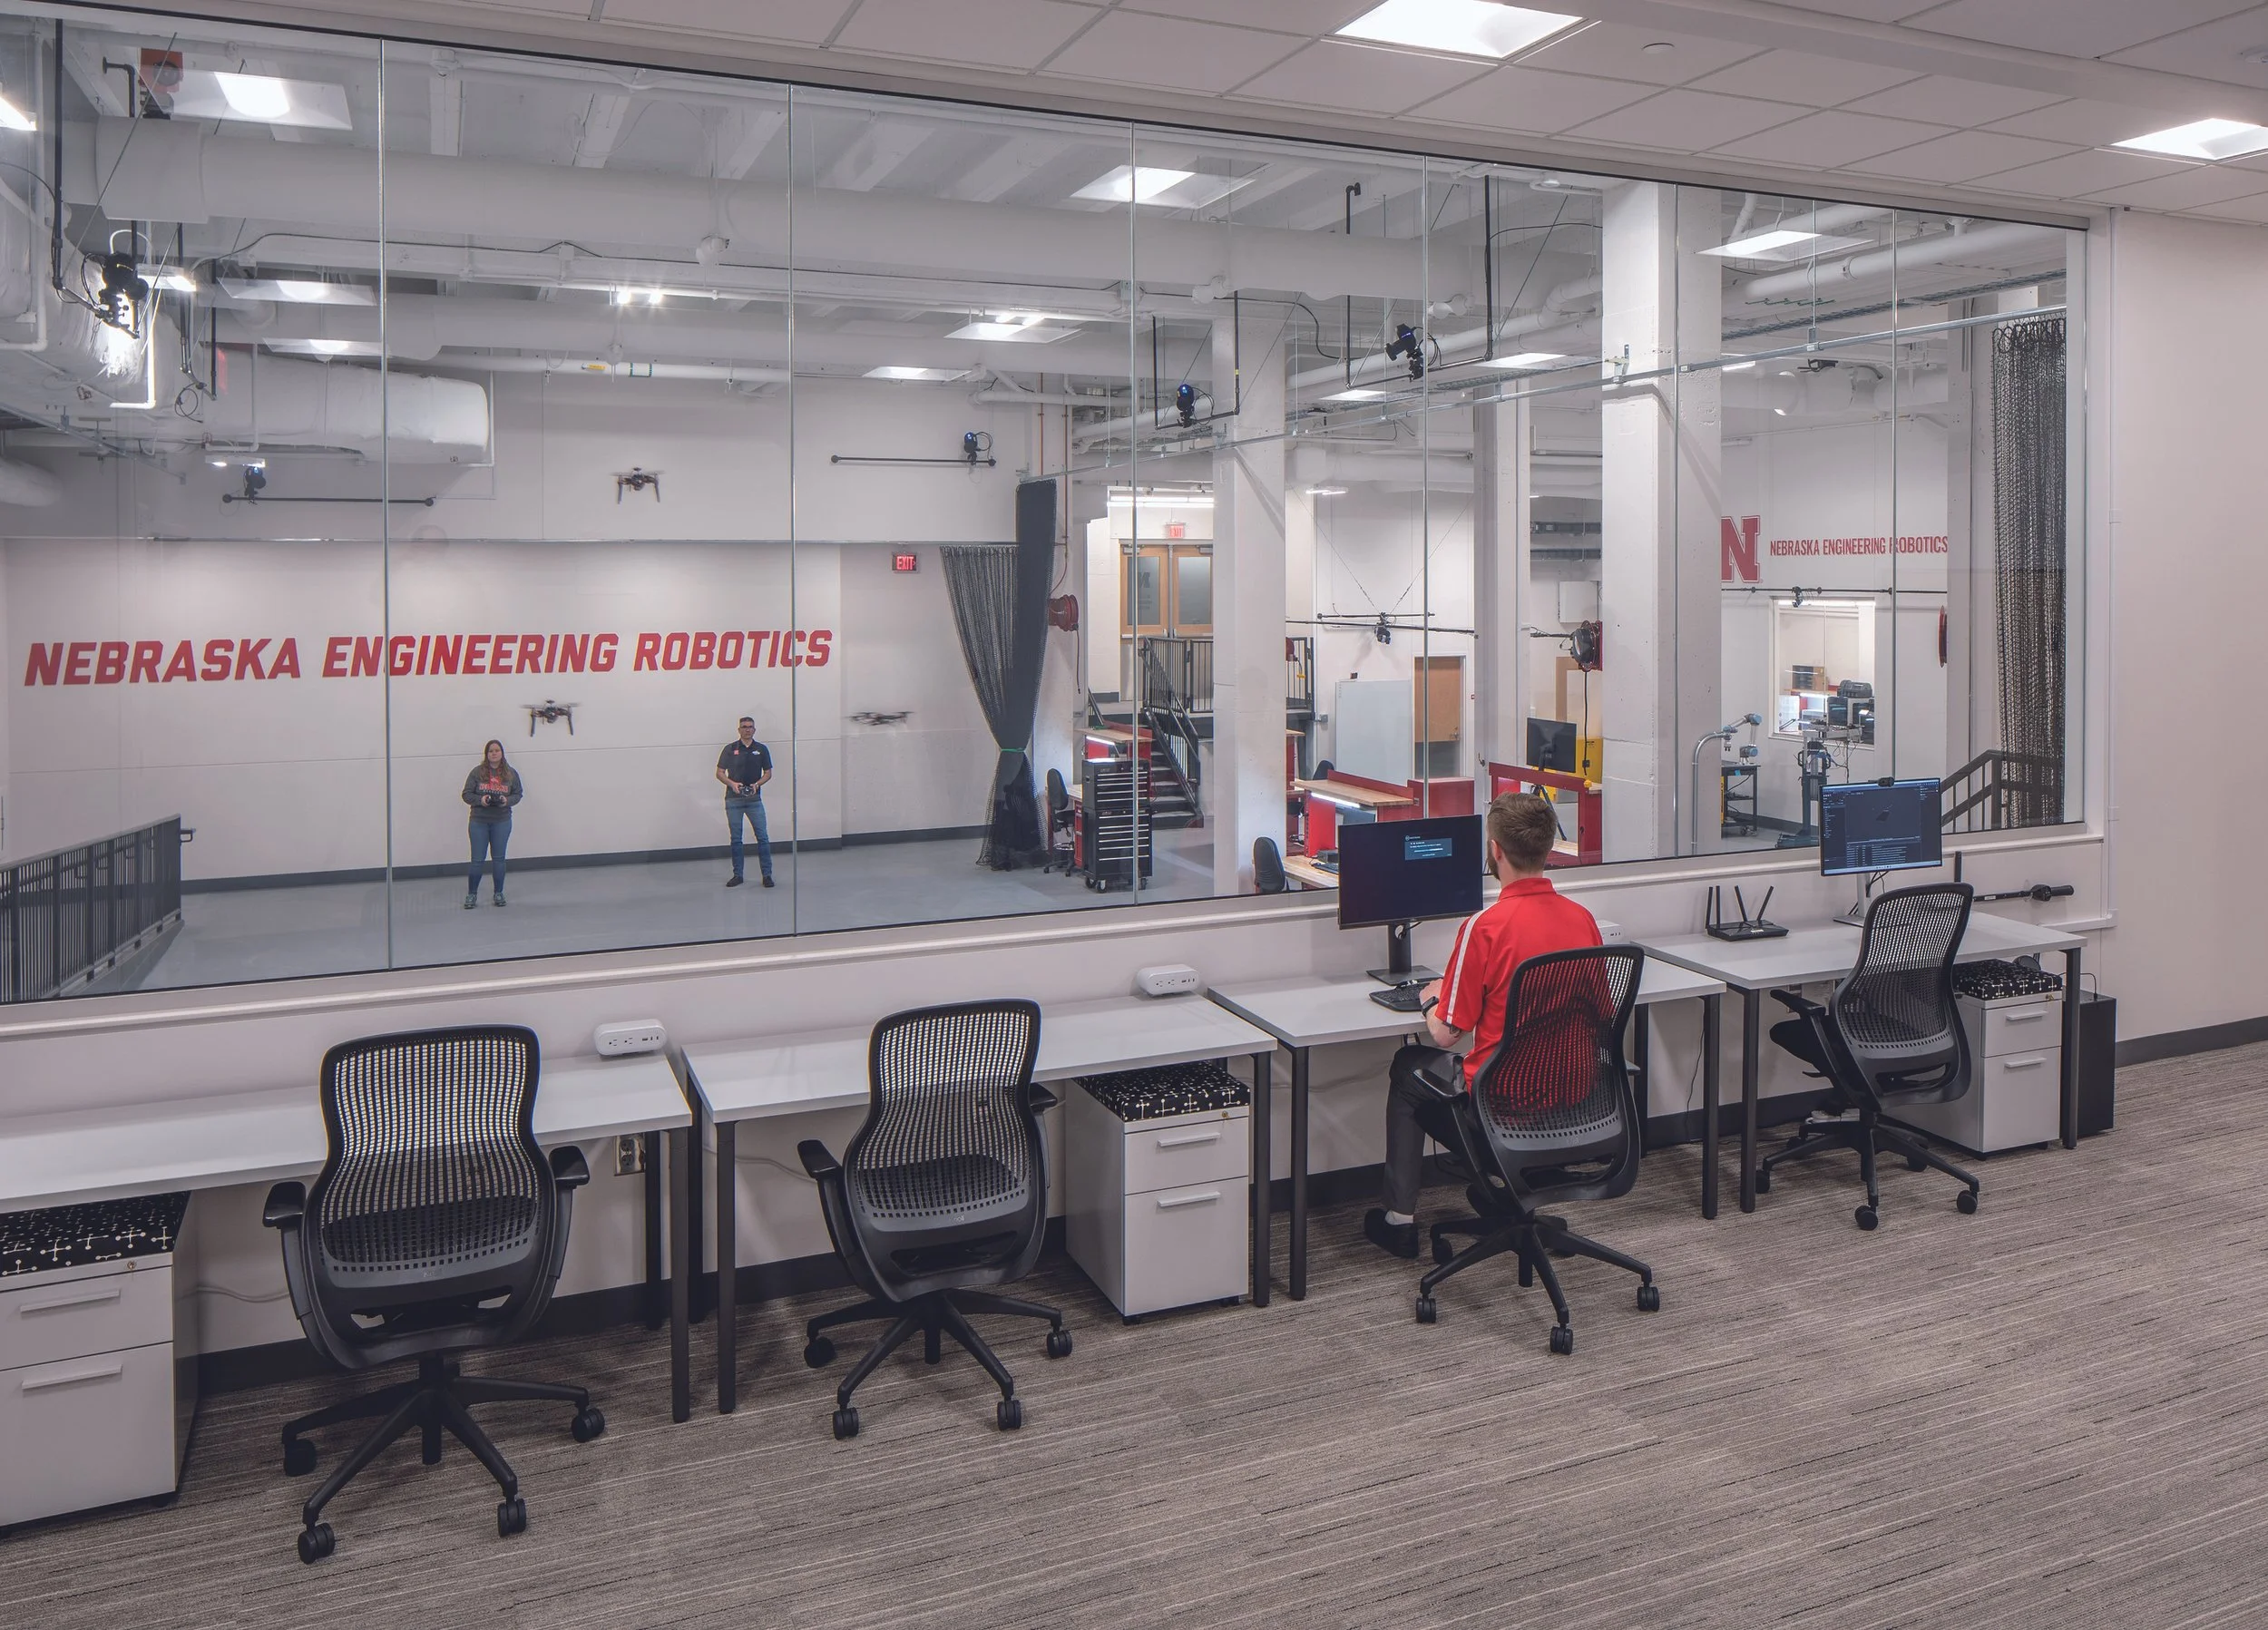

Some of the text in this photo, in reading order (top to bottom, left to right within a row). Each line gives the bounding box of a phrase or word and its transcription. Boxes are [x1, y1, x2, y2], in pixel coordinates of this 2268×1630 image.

[896, 556, 914, 570] EXIT
[1720, 515, 1761, 583] N
[1770, 539, 1820, 556] NEBRASKA
[1823, 537, 1886, 556] ENGINEERING
[24, 630, 833, 687] NEBRASKA ENGINEERING ROBOTICS
